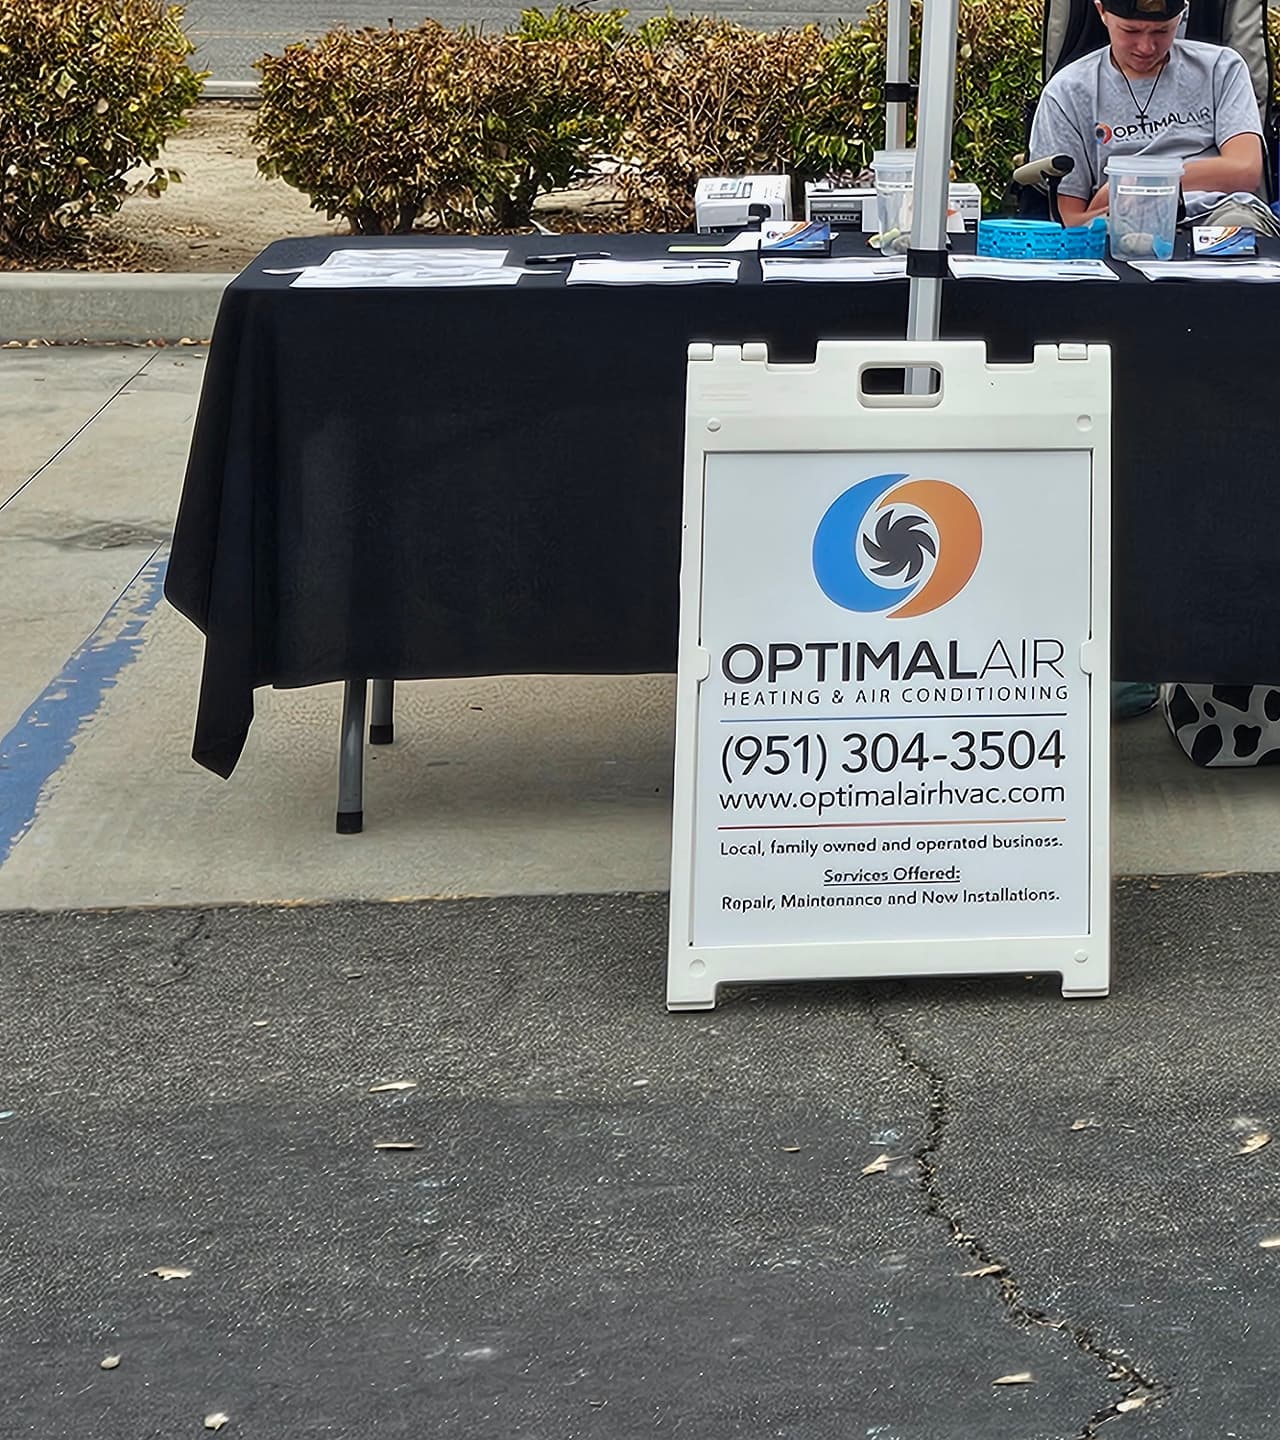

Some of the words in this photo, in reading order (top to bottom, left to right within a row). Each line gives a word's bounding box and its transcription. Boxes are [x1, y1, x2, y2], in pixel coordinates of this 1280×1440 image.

[1113, 106, 1212, 139] OPTIMALAIR
[720, 639, 1066, 684] OPTIMALAIR
[723, 690, 820, 707] HEATING
[831, 690, 845, 704] &
[855, 688, 891, 704] AIR
[901, 685, 1069, 703] CONDITIONING
[720, 733, 828, 783] (951)
[840, 728, 1067, 773] 304-3504
[719, 780, 1066, 816] www.optimalairhvac.com
[720, 840, 766, 858] Local,
[770, 838, 818, 858] family
[822, 837, 877, 854] owned
[881, 836, 911, 853] and
[915, 835, 988, 855] operated
[992, 834, 1064, 850] business.
[823, 867, 889, 882] Services
[893, 866, 961, 881] Offered:
[721, 896, 777, 913] Repair,
[780, 893, 882, 910] Maintenance
[887, 891, 917, 906] and
[921, 890, 959, 905] New
[962, 887, 1061, 904] Installations.
